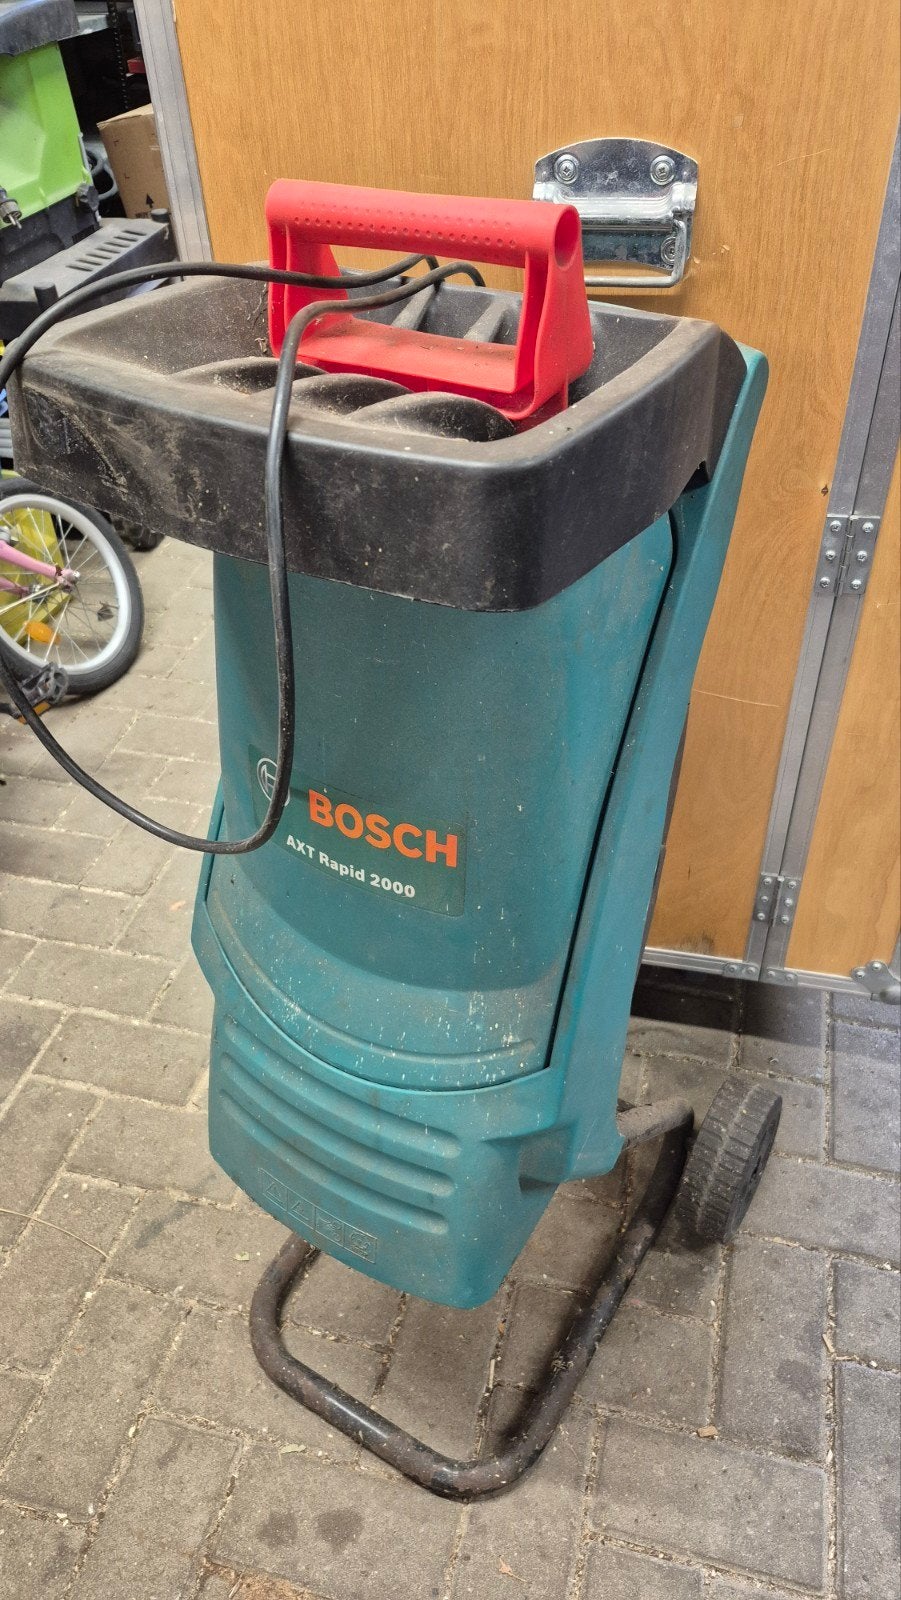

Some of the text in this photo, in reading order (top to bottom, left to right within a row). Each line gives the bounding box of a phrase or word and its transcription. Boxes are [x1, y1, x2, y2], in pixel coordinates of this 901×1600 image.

[308, 788, 458, 868] BOSCH
[286, 834, 416, 898] AXT Rapid 2000
